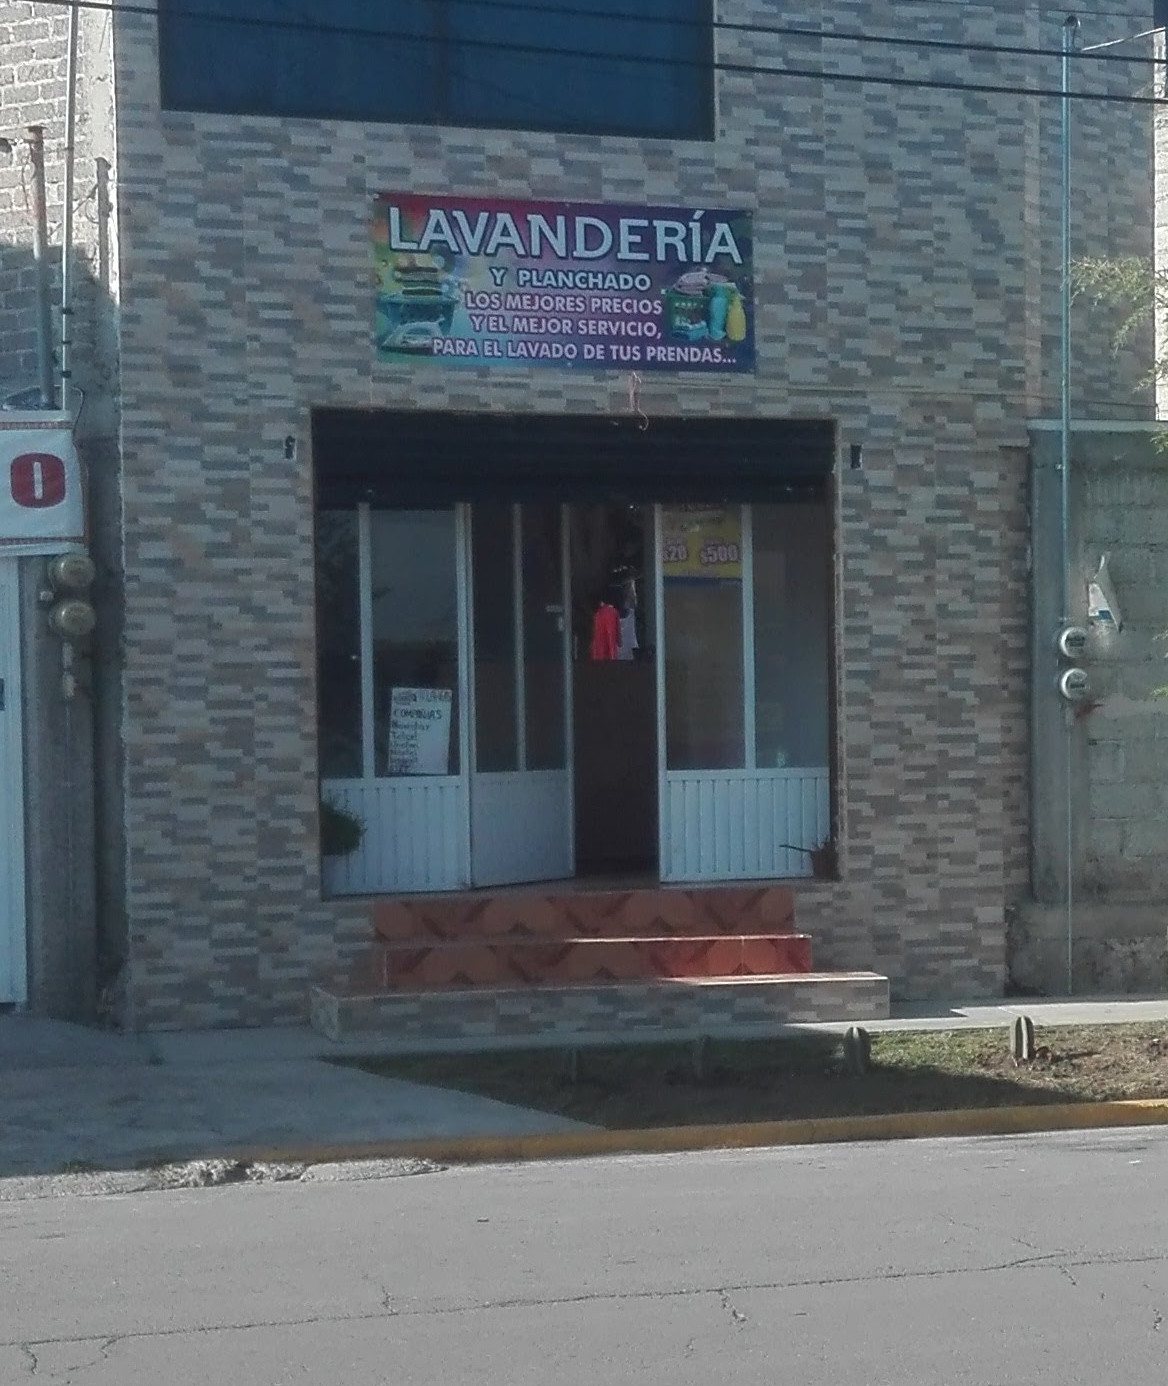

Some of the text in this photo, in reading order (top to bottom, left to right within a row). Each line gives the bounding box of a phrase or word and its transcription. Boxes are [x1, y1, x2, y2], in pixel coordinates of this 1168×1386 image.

[388, 206, 743, 265] LAVANDERÍA
[491, 268, 651, 291] Y PLANCHADO
[465, 292, 500, 309] LOS
[506, 295, 585, 313] MEJORES
[591, 298, 663, 315] PRECIOS
[470, 315, 662, 340] Y EL MEJOR SERVICIO,
[433, 339, 737, 363] PARA EL LAVADO DE TUS PRENDAS...
[700, 544, 739, 564] $500
